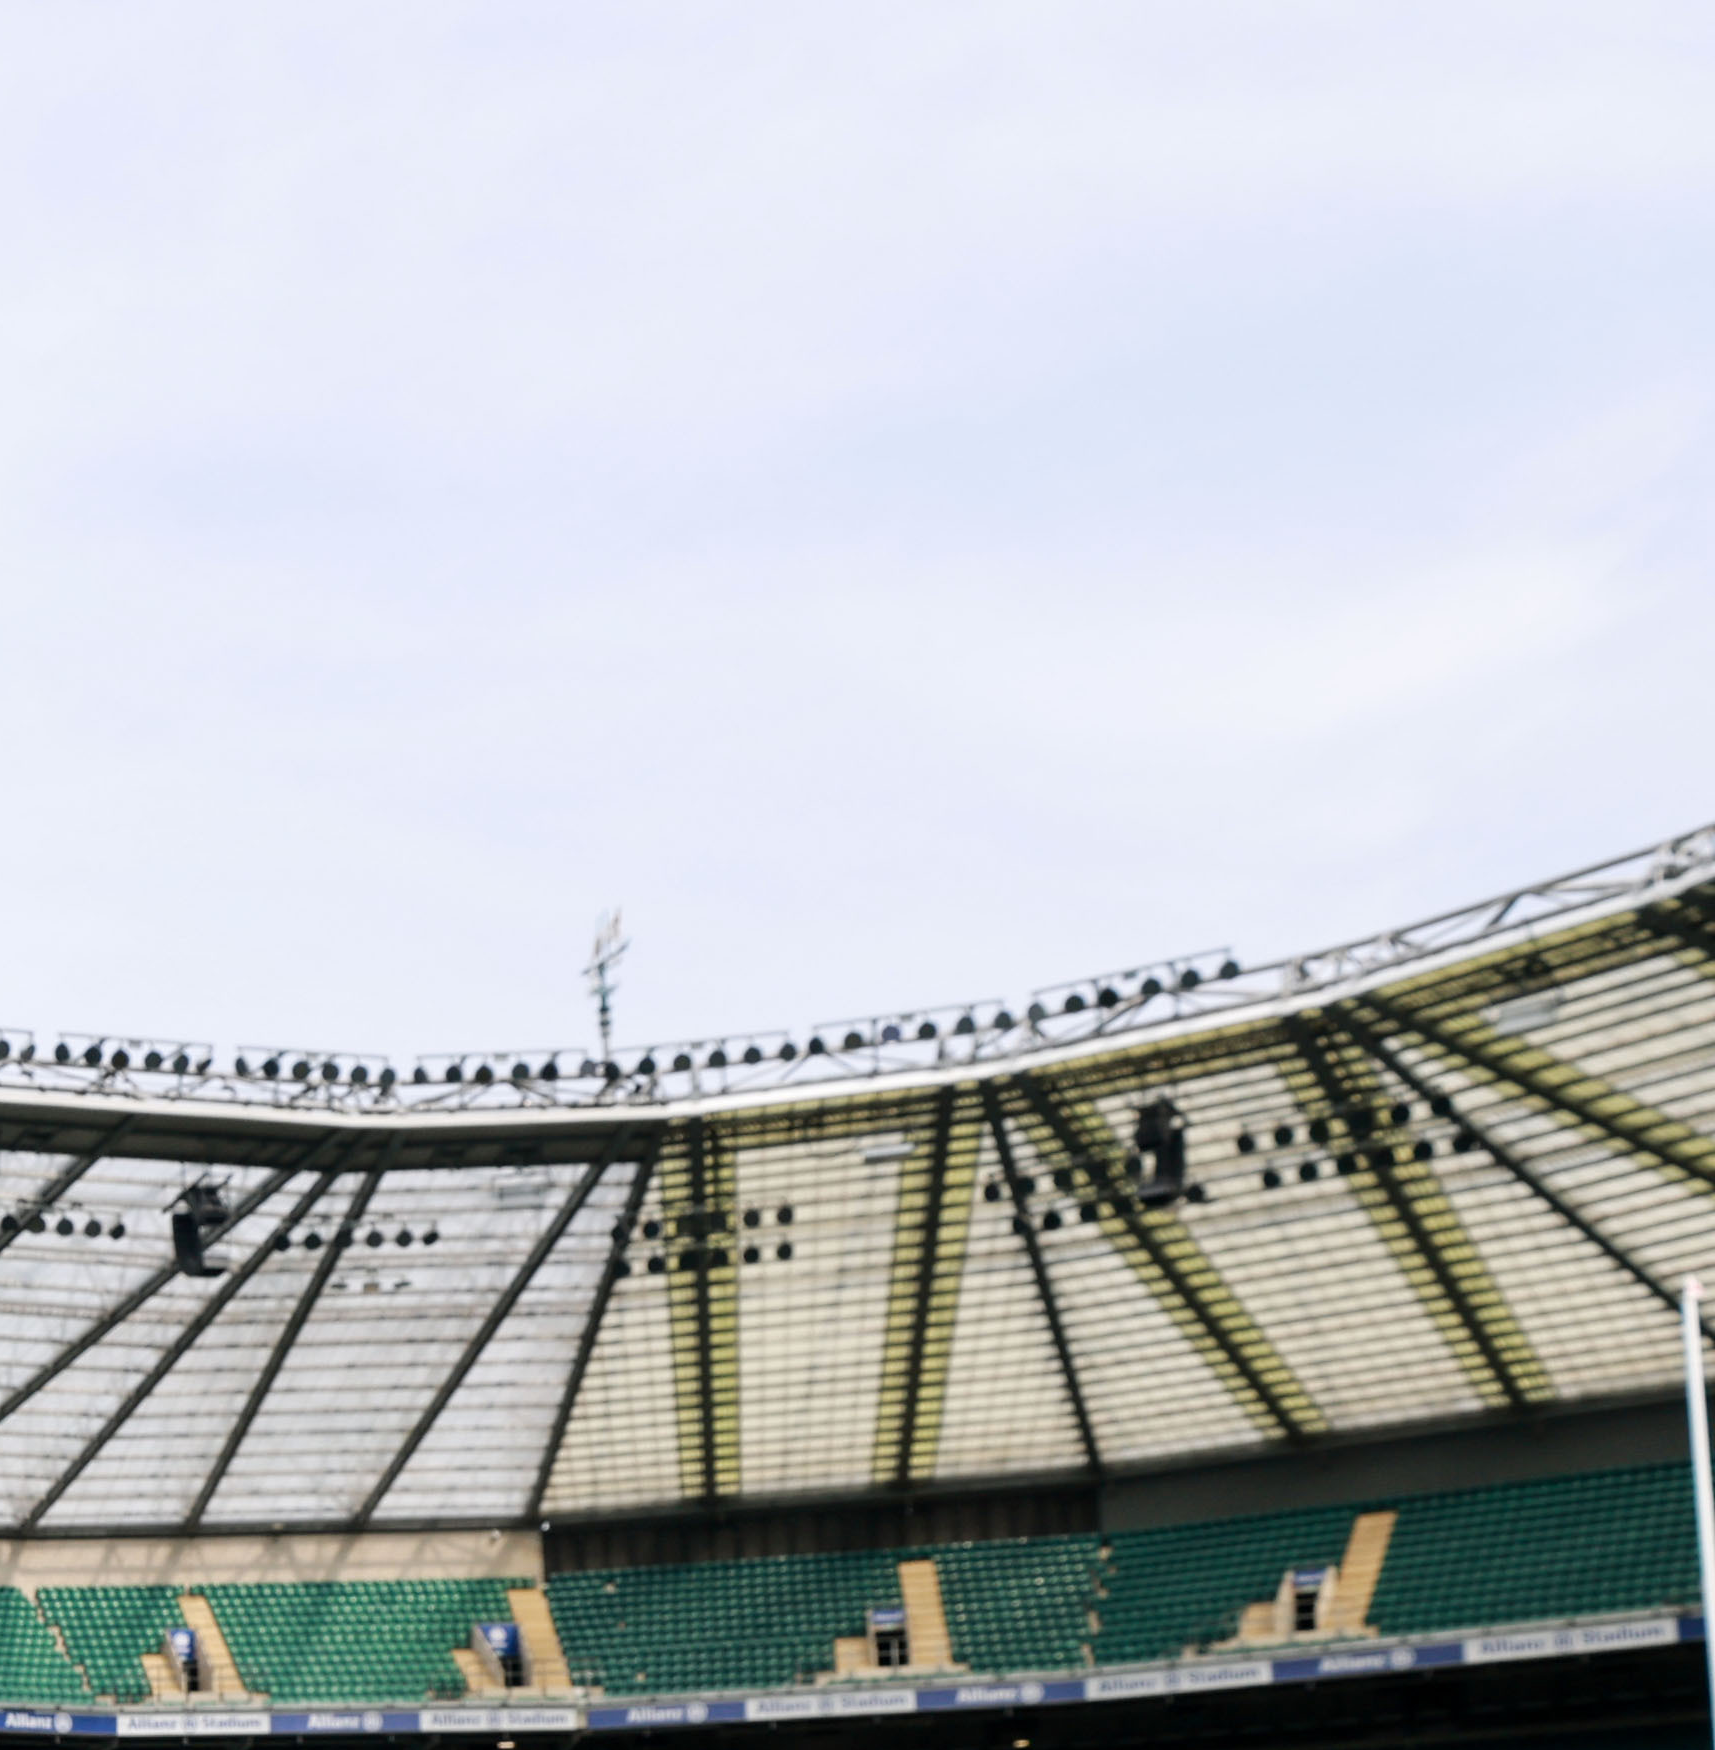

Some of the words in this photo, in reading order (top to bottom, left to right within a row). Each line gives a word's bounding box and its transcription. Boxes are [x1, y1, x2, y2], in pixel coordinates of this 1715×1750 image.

[5, 1712, 52, 1729] Allianz
[308, 1713, 359, 1730] Allianz
[627, 1705, 682, 1722] Allianz
